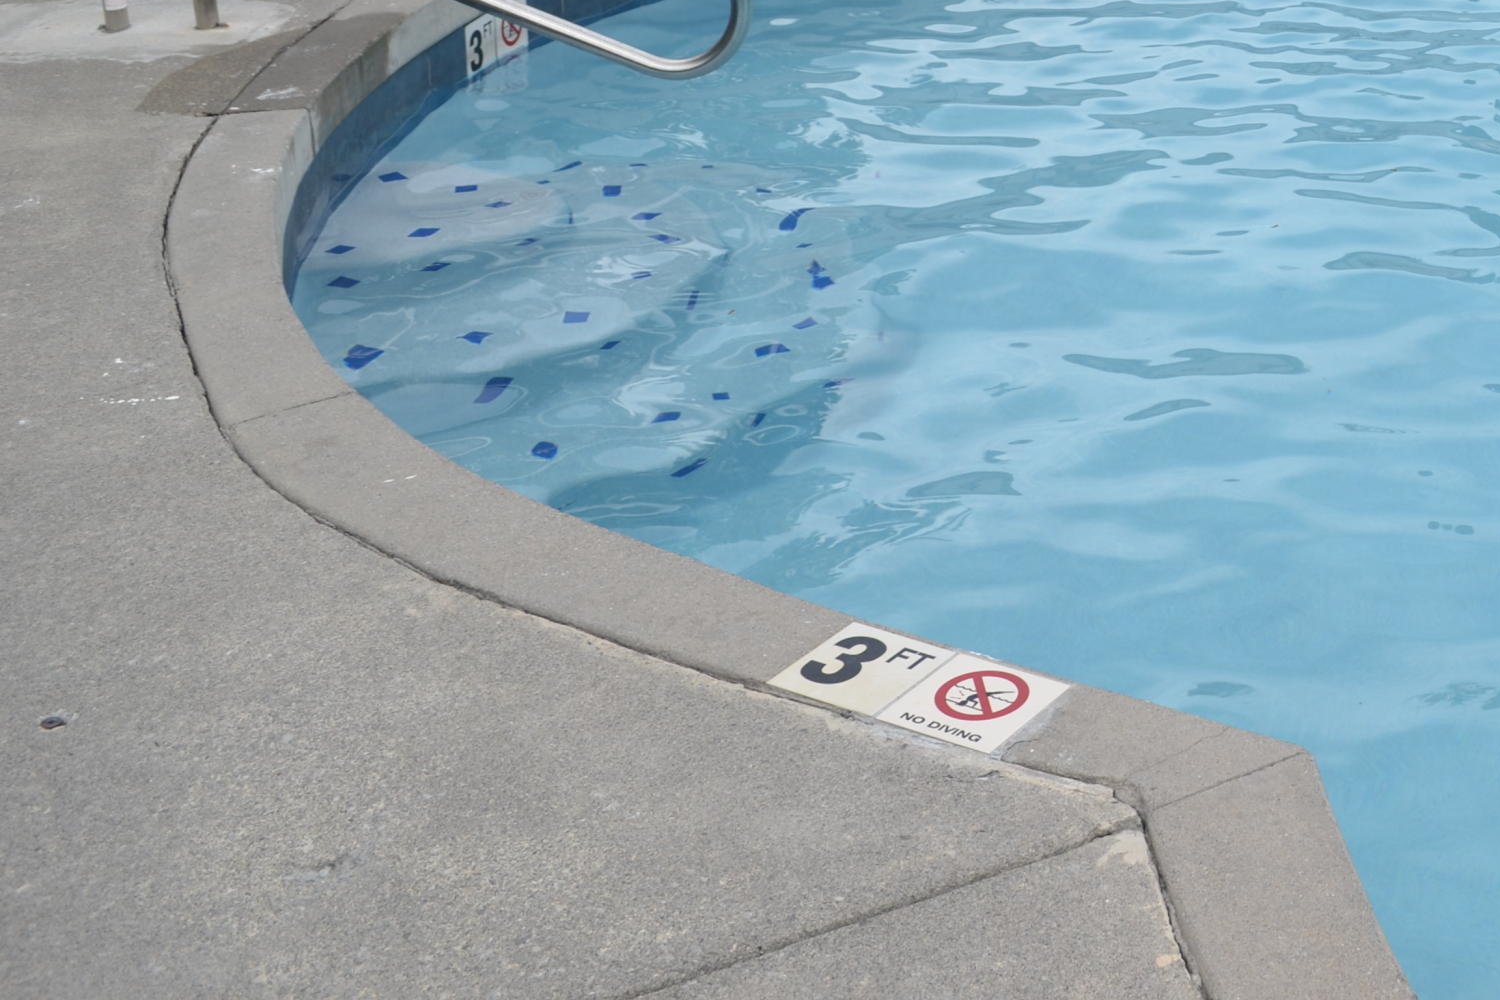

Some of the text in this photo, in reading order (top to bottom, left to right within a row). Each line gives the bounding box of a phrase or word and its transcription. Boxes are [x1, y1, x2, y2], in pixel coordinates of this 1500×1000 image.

[470, 20, 492, 72] 3 FT
[800, 636, 936, 684] 3 FT
[900, 712, 982, 742] NO DIVING
